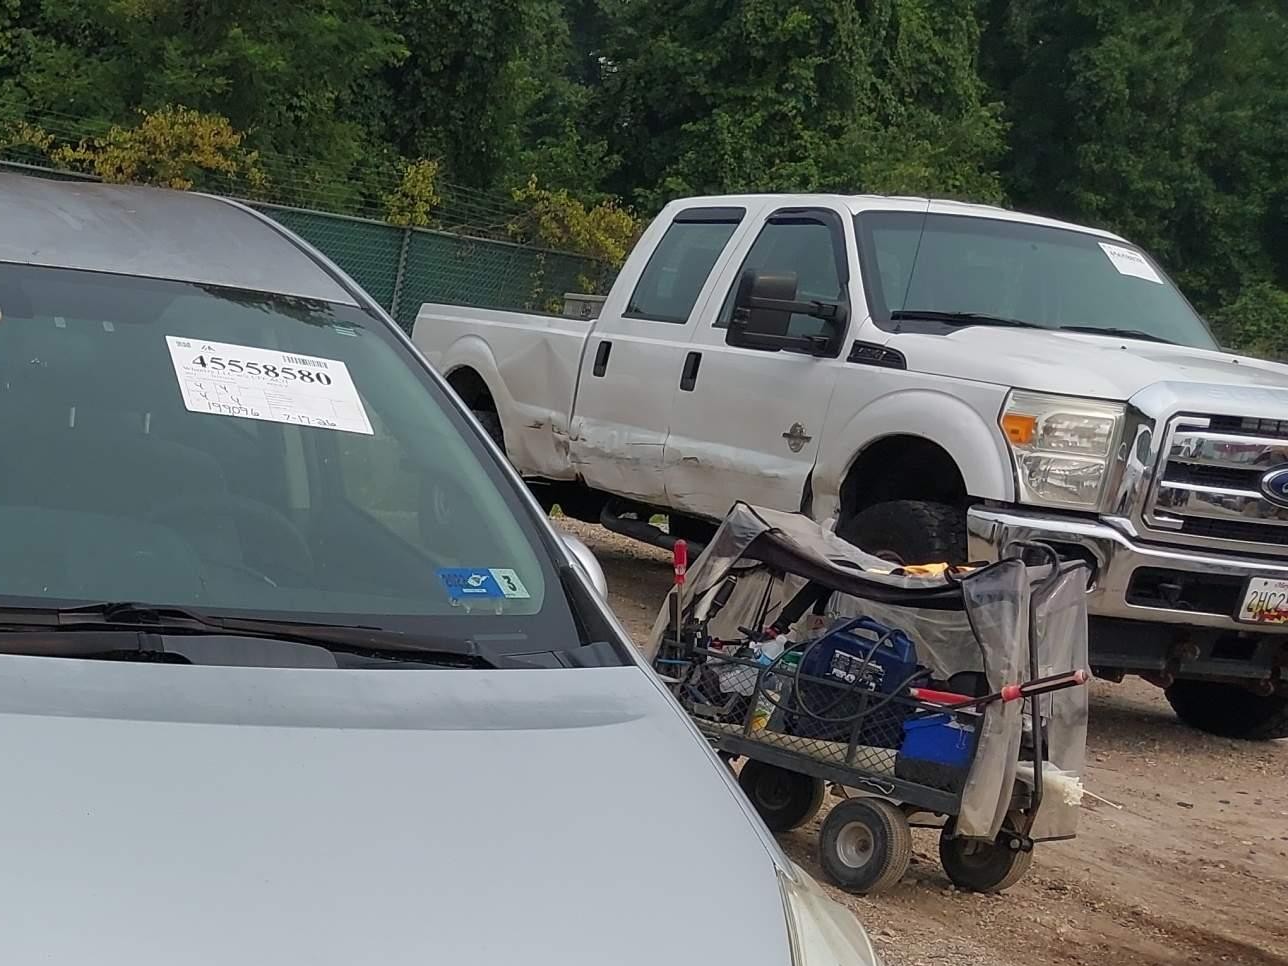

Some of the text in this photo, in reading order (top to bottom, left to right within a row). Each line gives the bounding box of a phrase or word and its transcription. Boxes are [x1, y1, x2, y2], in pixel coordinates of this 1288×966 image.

[192, 355, 331, 386] 45558580
[502, 575, 517, 592] 3
[1247, 590, 1288, 613] 2HC2
